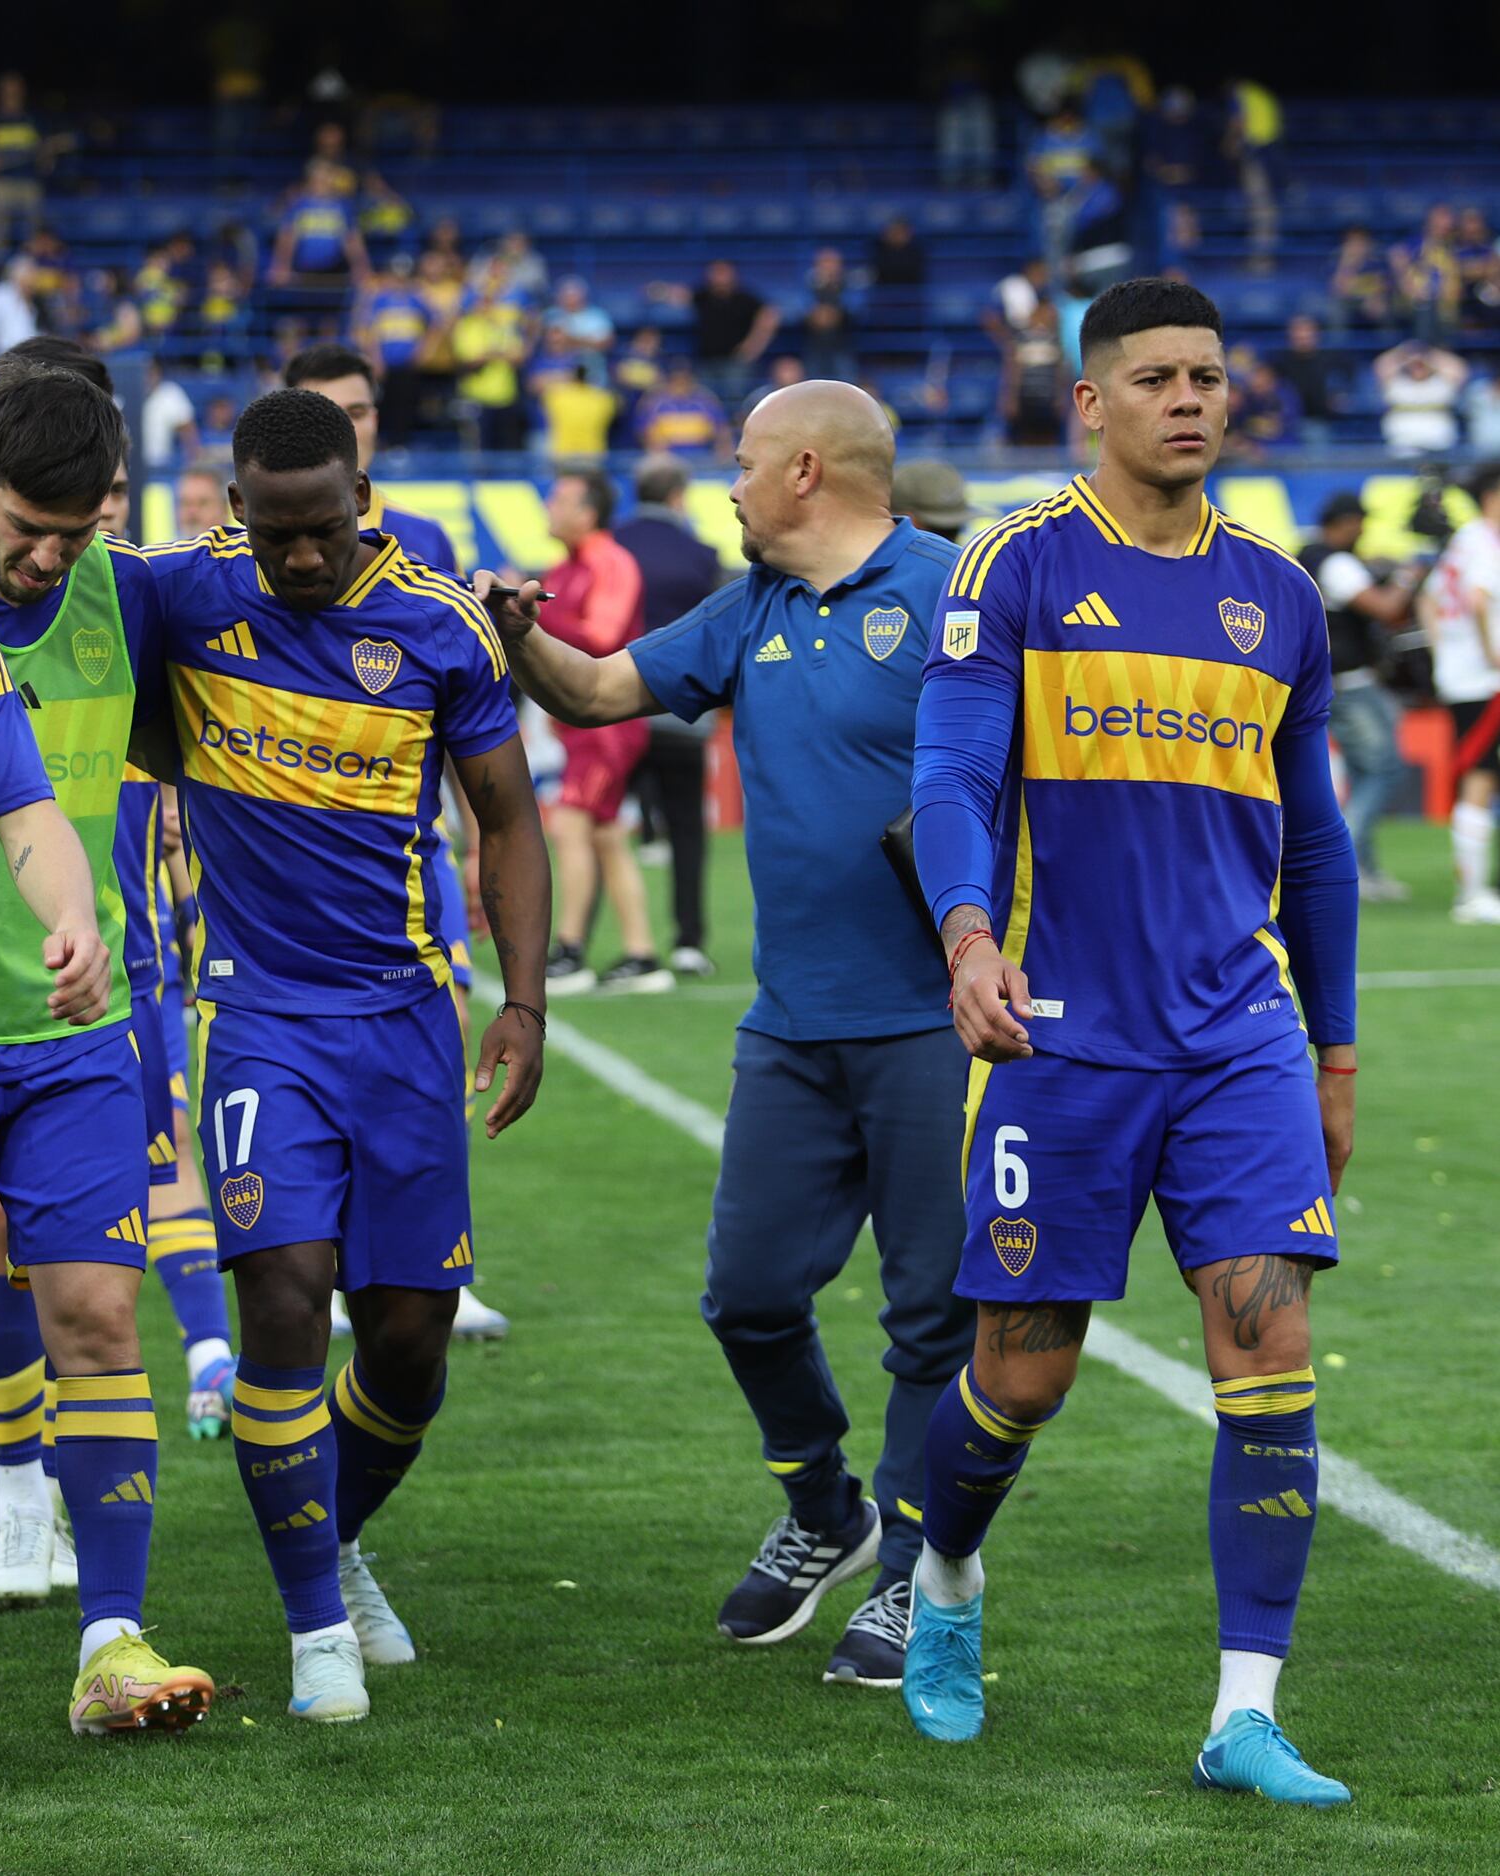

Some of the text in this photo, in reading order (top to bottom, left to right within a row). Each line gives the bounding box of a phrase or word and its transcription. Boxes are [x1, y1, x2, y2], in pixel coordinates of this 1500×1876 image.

[868, 625, 900, 636] CABJ
[1226, 614, 1259, 631] CABJ
[78, 647, 110, 659] CABJ
[755, 650, 792, 663] adidas
[358, 655, 394, 671] CABJ
[1064, 695, 1264, 754] betsson
[199, 708, 394, 780] betsson
[213, 1087, 260, 1174] 17
[993, 1125, 1030, 1210] 6
[227, 1188, 259, 1208] CABJ
[996, 1235, 1031, 1250] CABJ
[252, 1445, 319, 1478] CABJ
